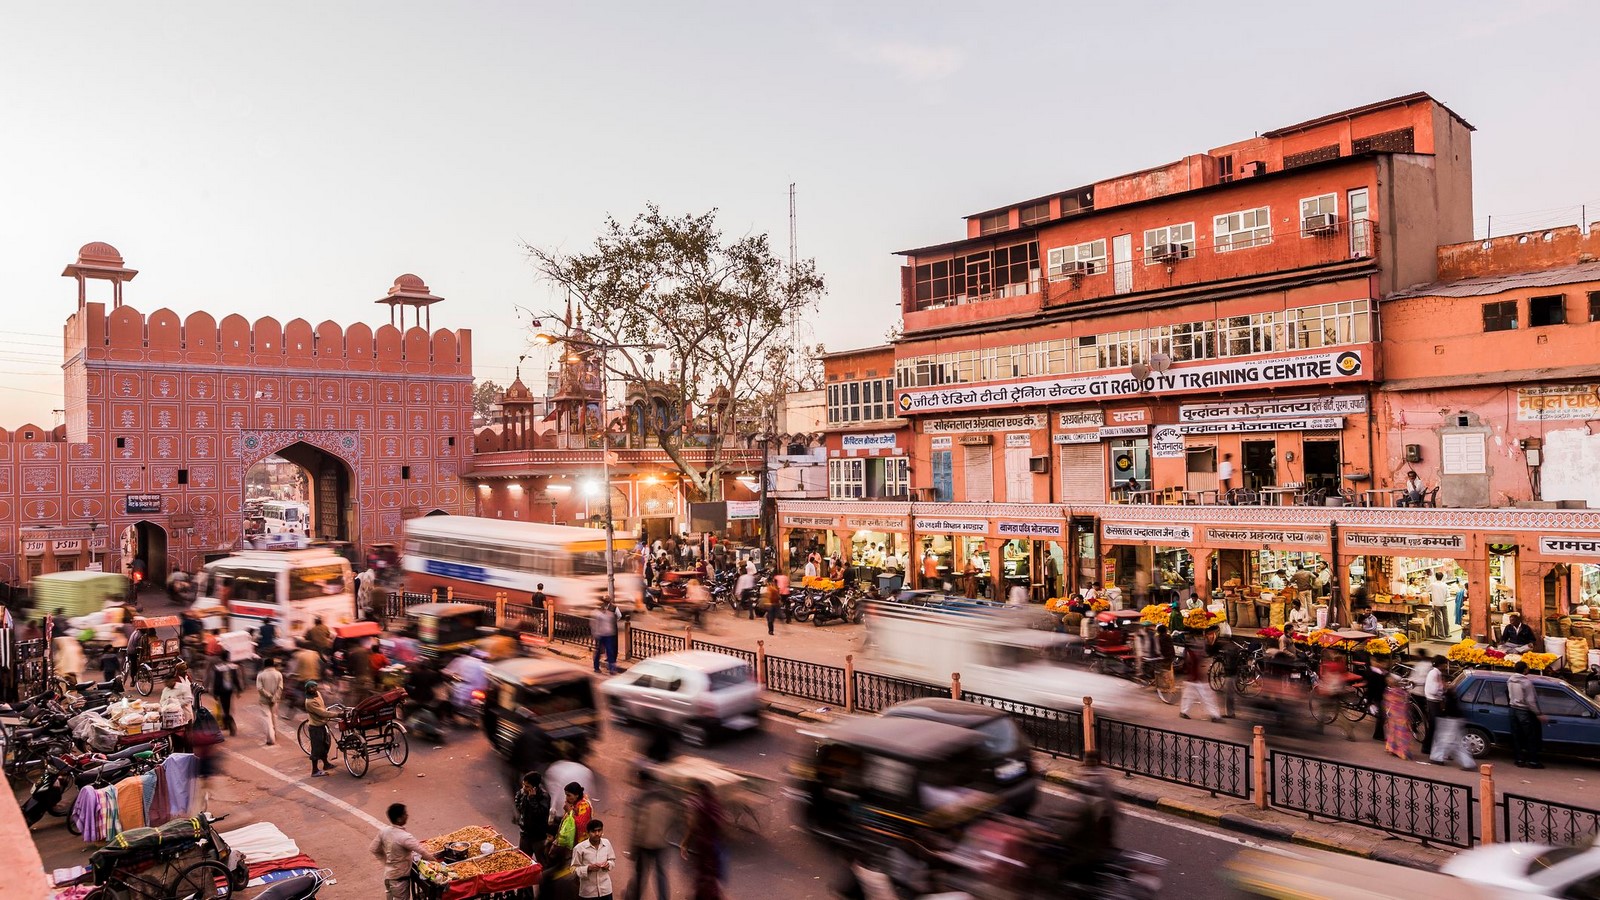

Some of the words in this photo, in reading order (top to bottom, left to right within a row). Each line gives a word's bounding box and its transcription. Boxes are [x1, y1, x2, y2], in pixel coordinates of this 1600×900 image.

[1089, 381, 1109, 395] GT
[1111, 376, 1155, 394] RADIO
[1156, 375, 1175, 389] TV
[1181, 365, 1264, 388] TRAINING
[1265, 359, 1332, 379] CENTRE
[913, 393, 939, 408] जीटी
[941, 390, 977, 405] रेडियो
[980, 387, 1008, 402] टीवी
[1010, 385, 1046, 403] ट्रेनिंग
[1049, 382, 1086, 398] सेन्टर
[1233, 402, 1311, 415] भोजनालय
[1519, 396, 1562, 410] नवल
[1112, 410, 1145, 422] रास्ता
[933, 417, 972, 431] सोहनलाल
[973, 416, 1005, 429] अग्रवाल
[1006, 417, 1023, 427] एण्ड
[1179, 424, 1228, 434] वृन्दावन
[1231, 421, 1307, 432] भोजनालय
[1072, 432, 1098, 441] COMPUTERS
[1154, 428, 1182, 441] वृन्दावन
[1153, 441, 1183, 451] भोजनालय
[1031, 522, 1059, 534] भोजनालय
[1105, 526, 1133, 536] केसरलाल
[1162, 527, 1174, 537] जैन
[1208, 528, 1248, 540] पोखरमल
[1249, 530, 1284, 542] प्रहलाद
[1286, 532, 1304, 542] राय
[1347, 532, 1379, 545] गोपाल
[1422, 534, 1462, 547] कम्पनी
